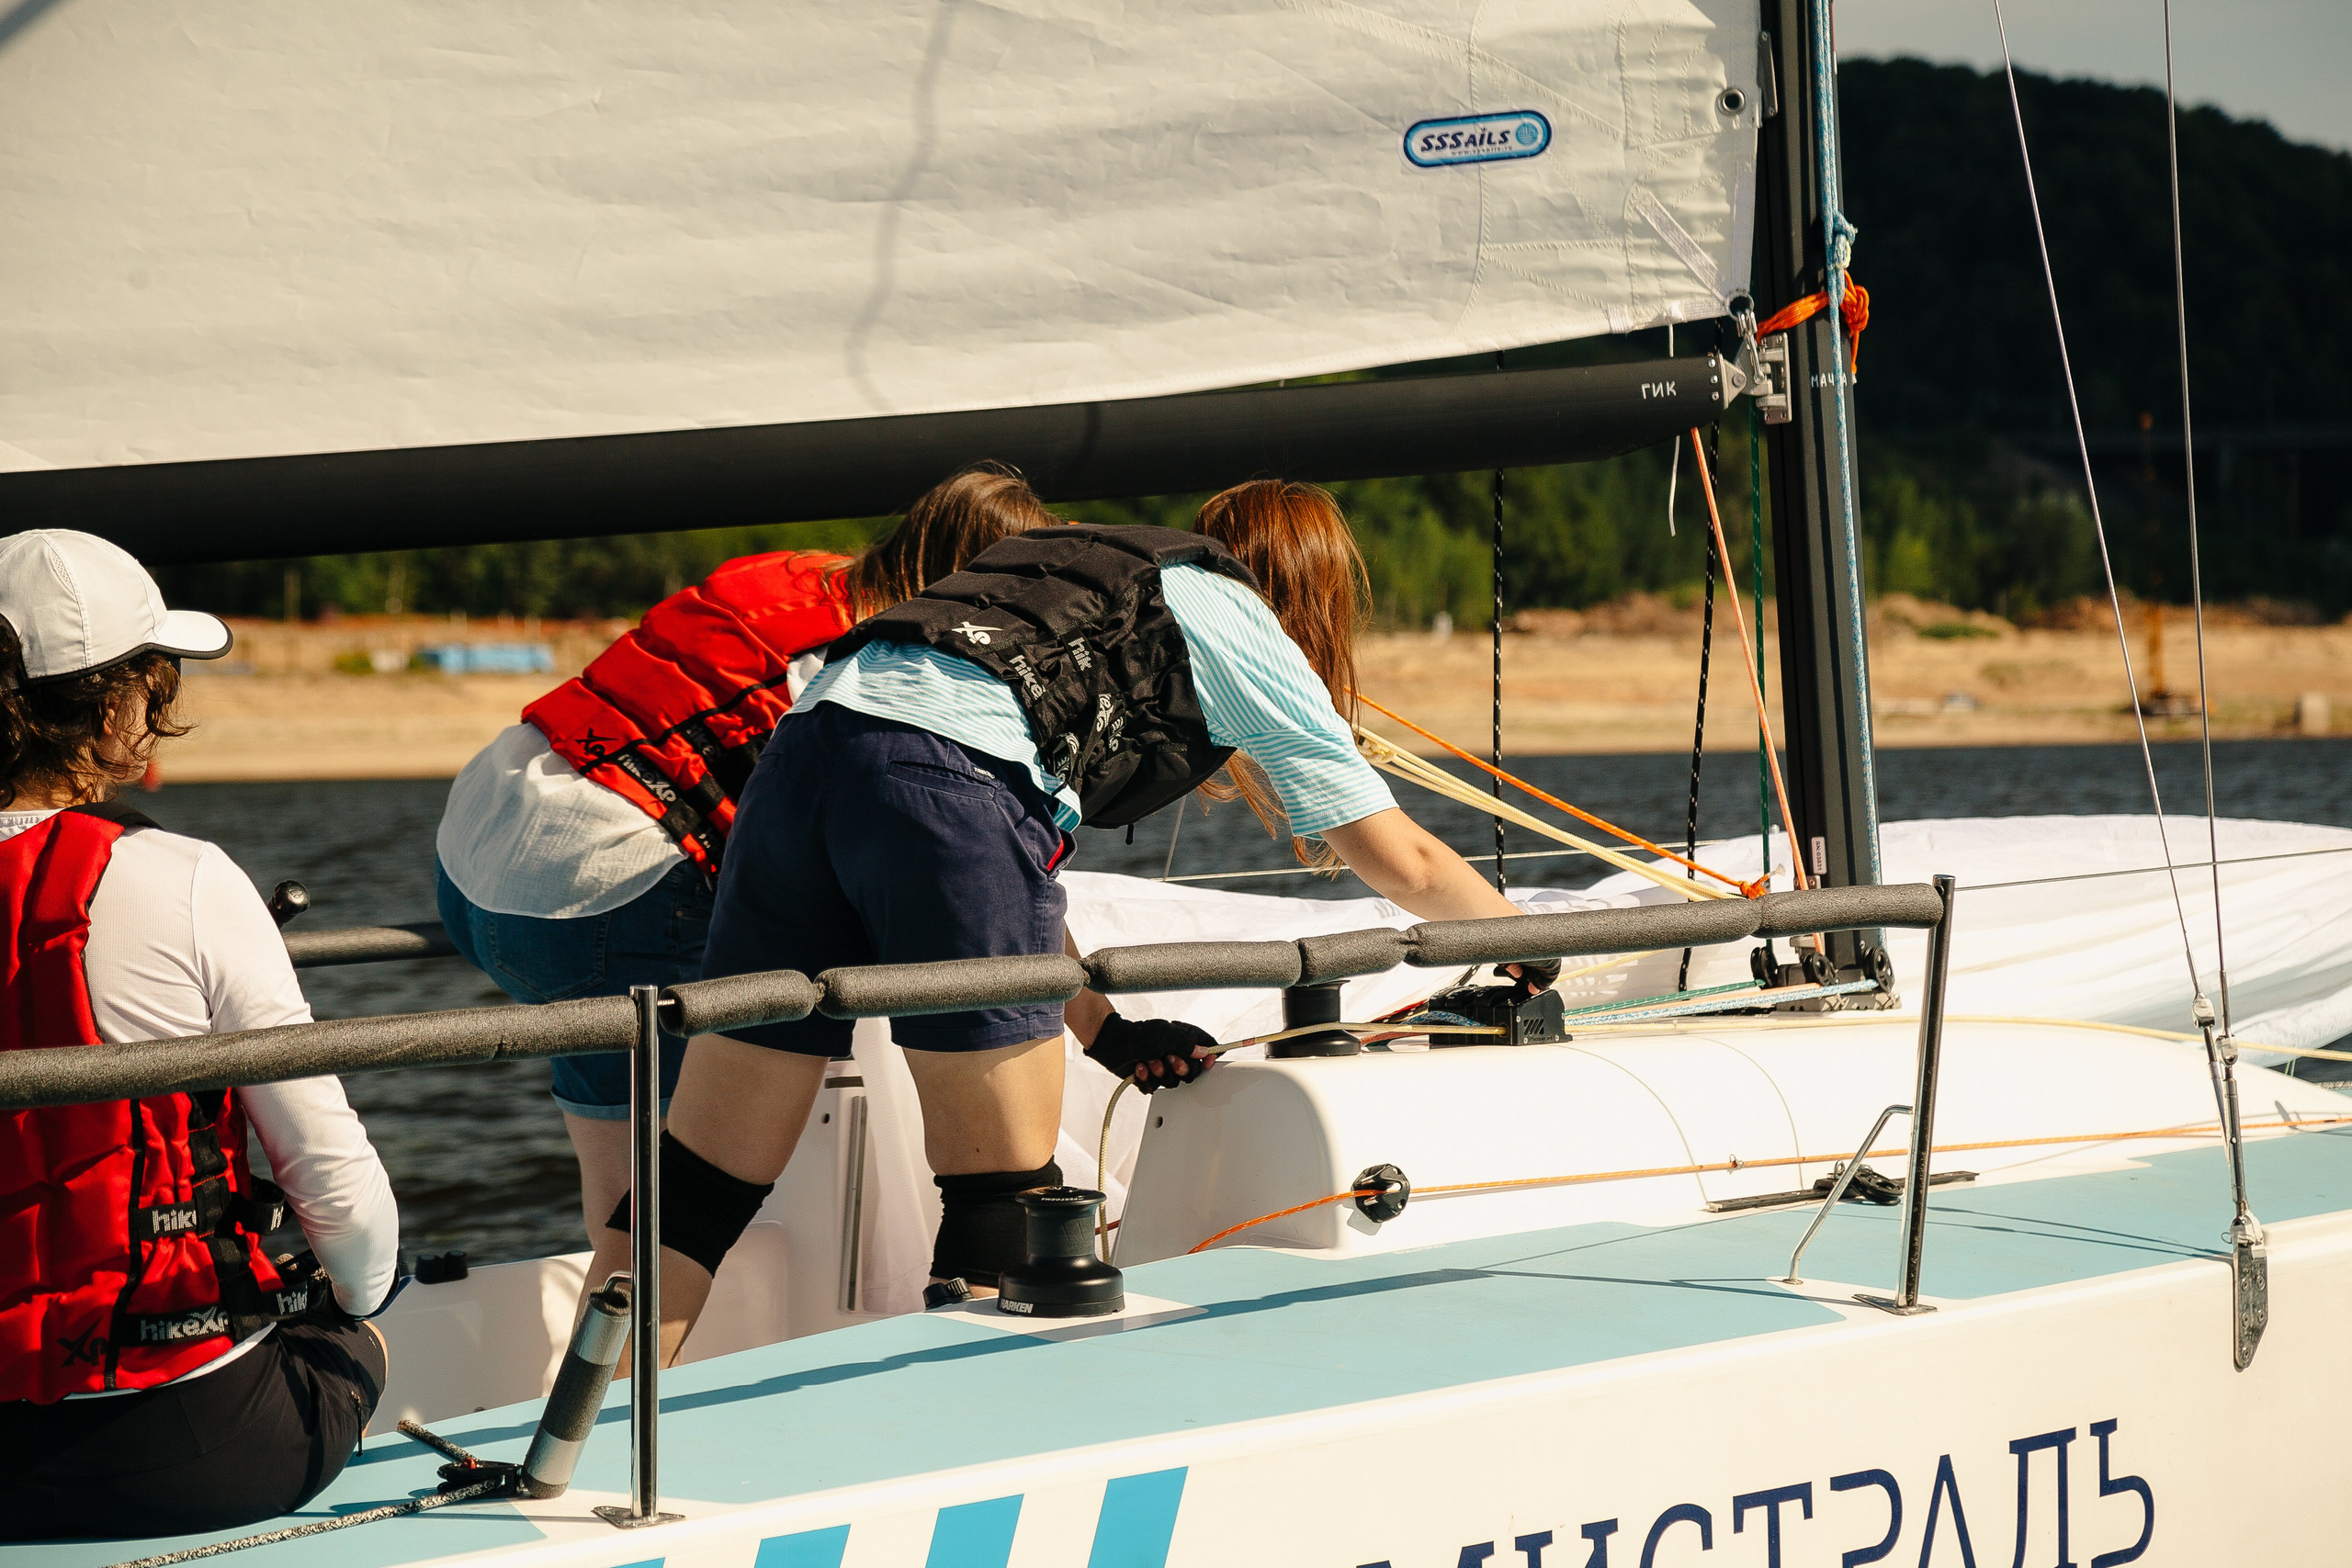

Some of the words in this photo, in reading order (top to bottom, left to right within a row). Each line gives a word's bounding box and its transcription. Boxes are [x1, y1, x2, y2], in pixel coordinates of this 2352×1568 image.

[1811, 371, 1848, 388] МАЧА
[1641, 380, 1678, 400] ГИК
[1000, 1298, 1034, 1314] HARKEN
